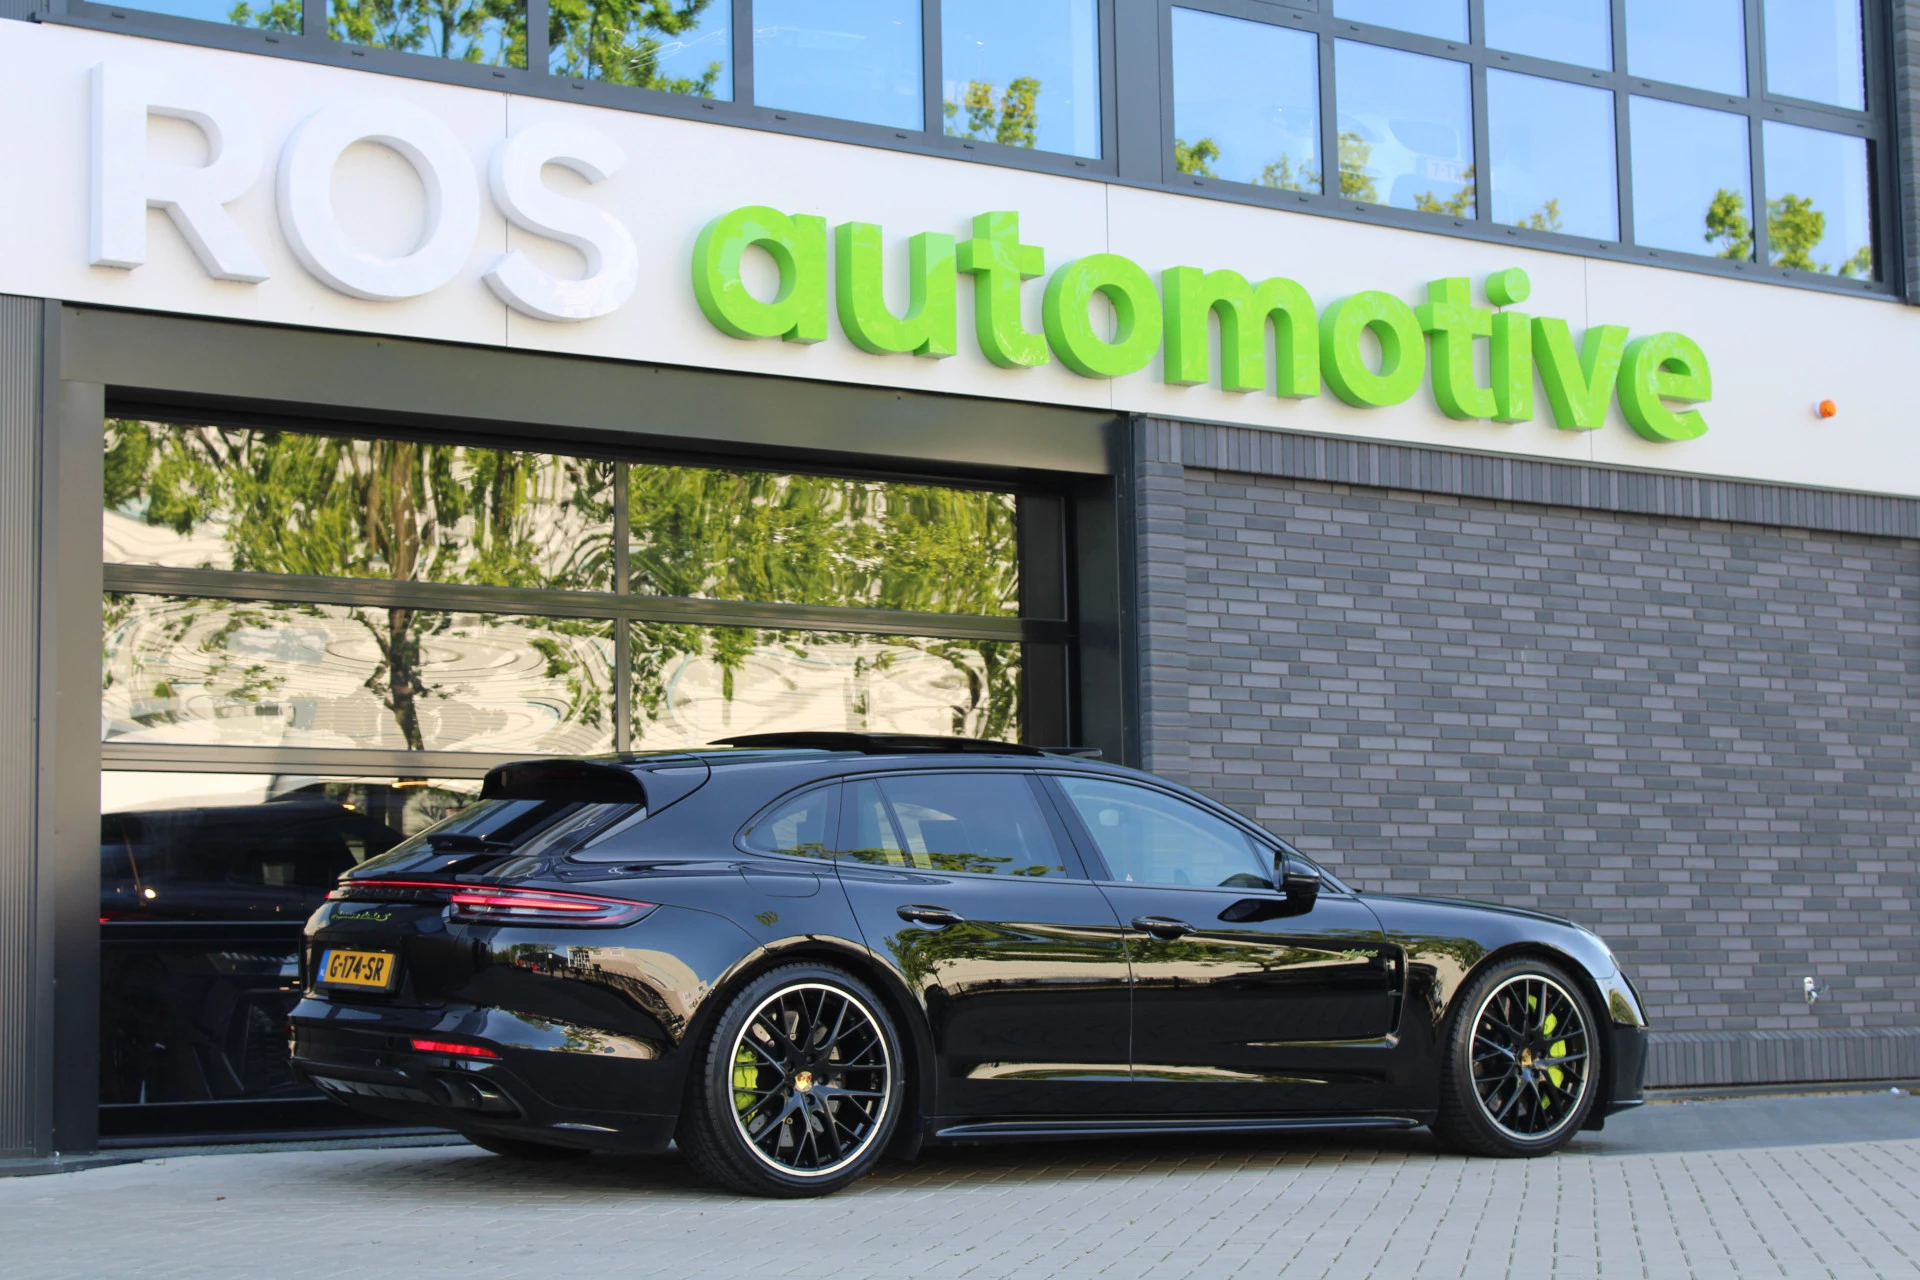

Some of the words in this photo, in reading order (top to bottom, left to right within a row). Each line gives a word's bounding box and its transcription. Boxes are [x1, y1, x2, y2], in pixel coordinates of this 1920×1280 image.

[89, 61, 639, 323] ROS
[692, 204, 1712, 444] automotive
[329, 954, 385, 981] G-174-SR
